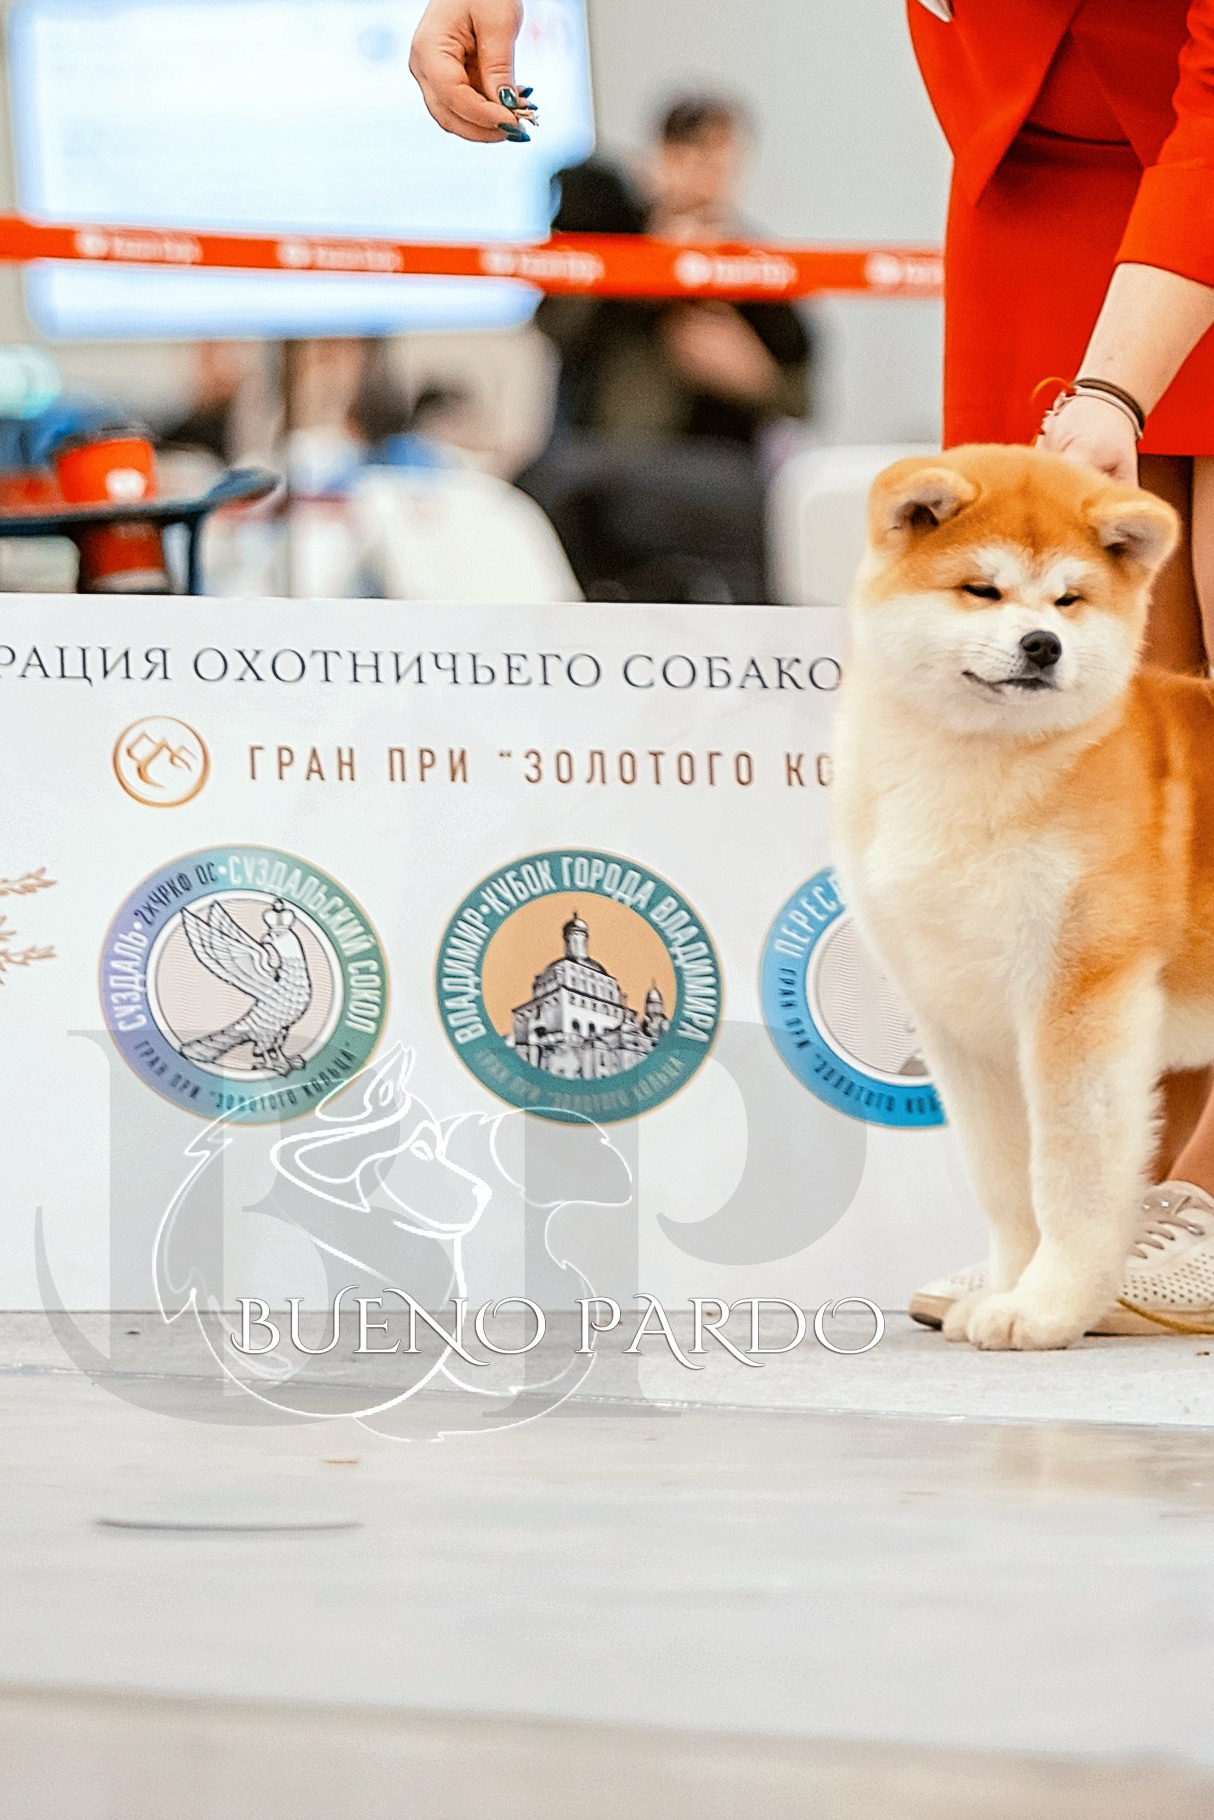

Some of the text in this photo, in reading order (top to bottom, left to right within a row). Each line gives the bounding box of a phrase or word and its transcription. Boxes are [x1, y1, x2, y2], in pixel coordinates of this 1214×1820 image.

[193, 647, 601, 689] ОХОТНИЧЬЕГО
[622, 653, 842, 692] СОБАКО
[248, 744, 357, 782] ГРАН
[388, 745, 468, 783] ПРИ
[109, 929, 148, 1032] СУЗДАЛЬ
[198, 861, 219, 885] ОС
[228, 854, 378, 957] СУЗДАЛЬСКИЙ
[345, 959, 382, 1035] СОКОЛ
[443, 856, 718, 1045] ВЛАДИМИР КУБОК ГОРОДА ВЛАДИМИРА
